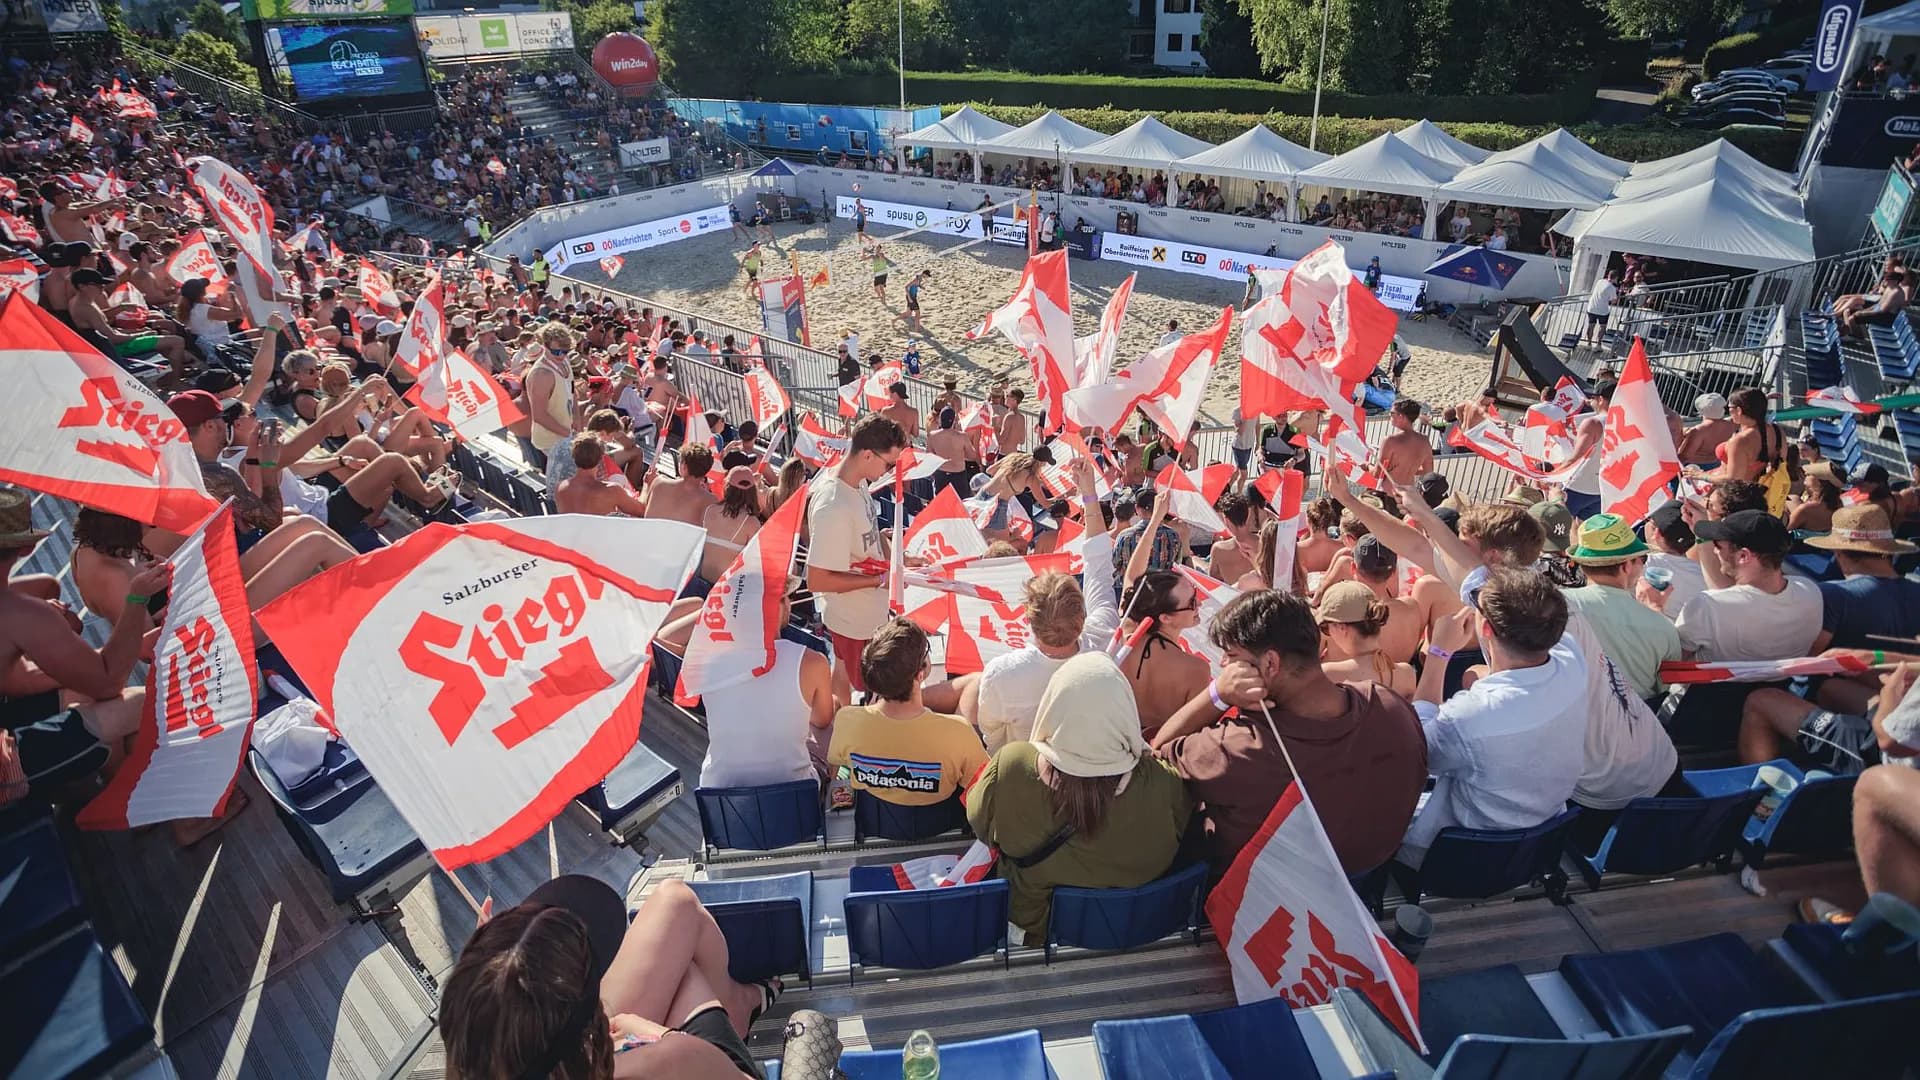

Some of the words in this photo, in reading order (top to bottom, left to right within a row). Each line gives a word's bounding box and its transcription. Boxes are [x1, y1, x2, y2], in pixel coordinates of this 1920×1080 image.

[611, 58, 649, 71] win2day
[629, 146, 662, 157] HOLTER
[887, 209, 914, 221] spusu
[1190, 215, 1210, 223] HOLTER
[1234, 221, 1256, 229] HOLTER
[1281, 226, 1303, 235] HOLTER
[658, 226, 679, 237] Sport
[1329, 234, 1354, 242] HOLTER
[1119, 243, 1150, 255] Raiffeisen
[1381, 241, 1407, 250] HOLTER
[1104, 247, 1150, 261] Oberösterreich
[1384, 291, 1413, 302] regional
[442, 558, 540, 606] Salzburger
[174, 615, 224, 740] Stiegl
[857, 770, 935, 791] patagonia
